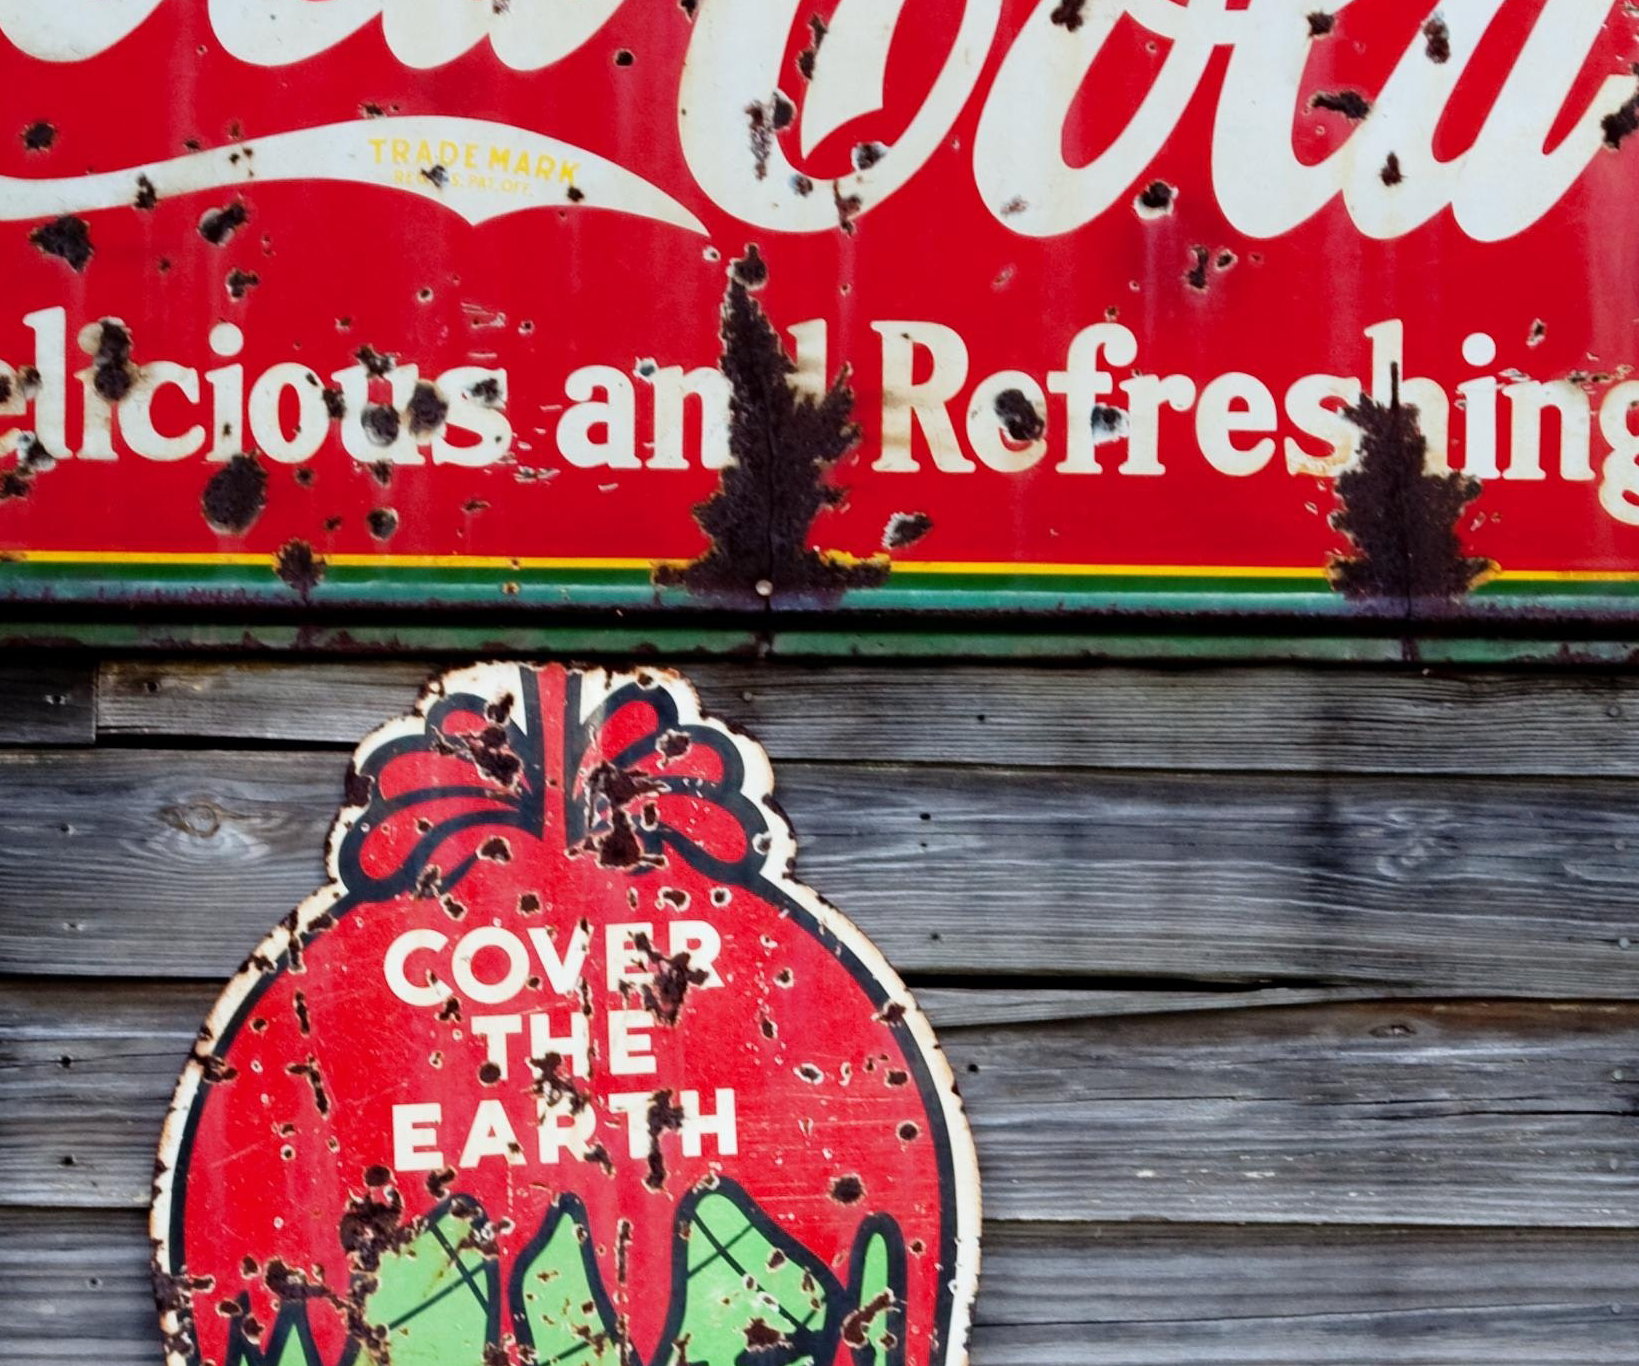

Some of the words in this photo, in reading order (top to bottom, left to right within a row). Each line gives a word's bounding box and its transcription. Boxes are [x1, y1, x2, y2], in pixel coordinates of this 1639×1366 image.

[368, 137, 480, 170] TRADE
[487, 145, 581, 186] MARK
[383, 919, 725, 1008] COVER
[470, 1009, 658, 1081] THE
[391, 1087, 739, 1173] EARTH
